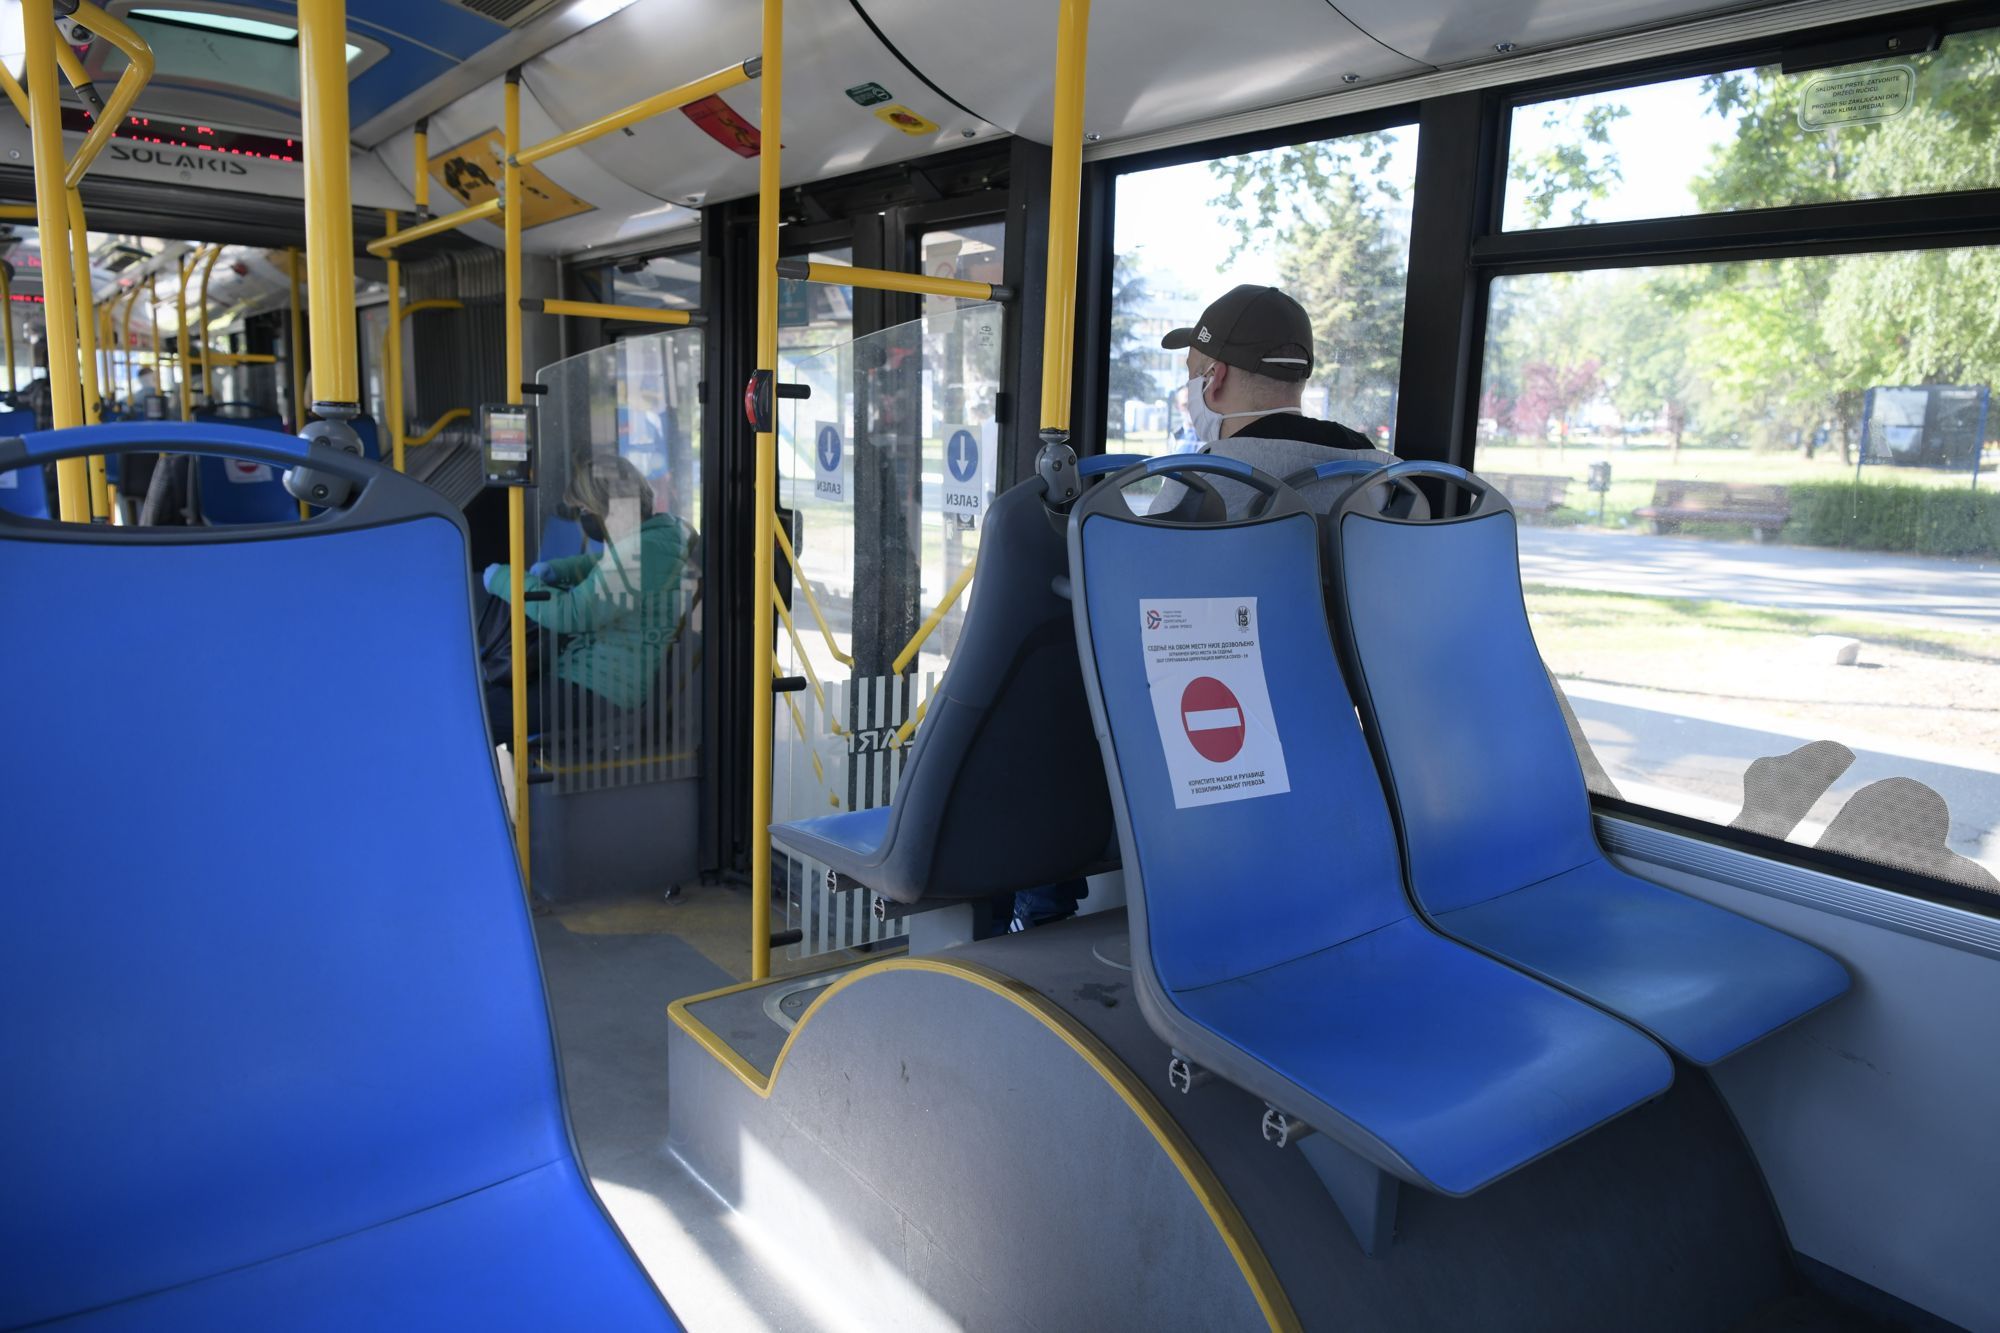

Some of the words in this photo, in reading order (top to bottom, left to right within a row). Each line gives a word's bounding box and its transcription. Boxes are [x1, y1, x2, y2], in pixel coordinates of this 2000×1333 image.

[111, 145, 247, 175] SOLARIS
[816, 479, 841, 495] ИЗЛАЗ
[946, 492, 979, 508] ИЗЛАЗ
